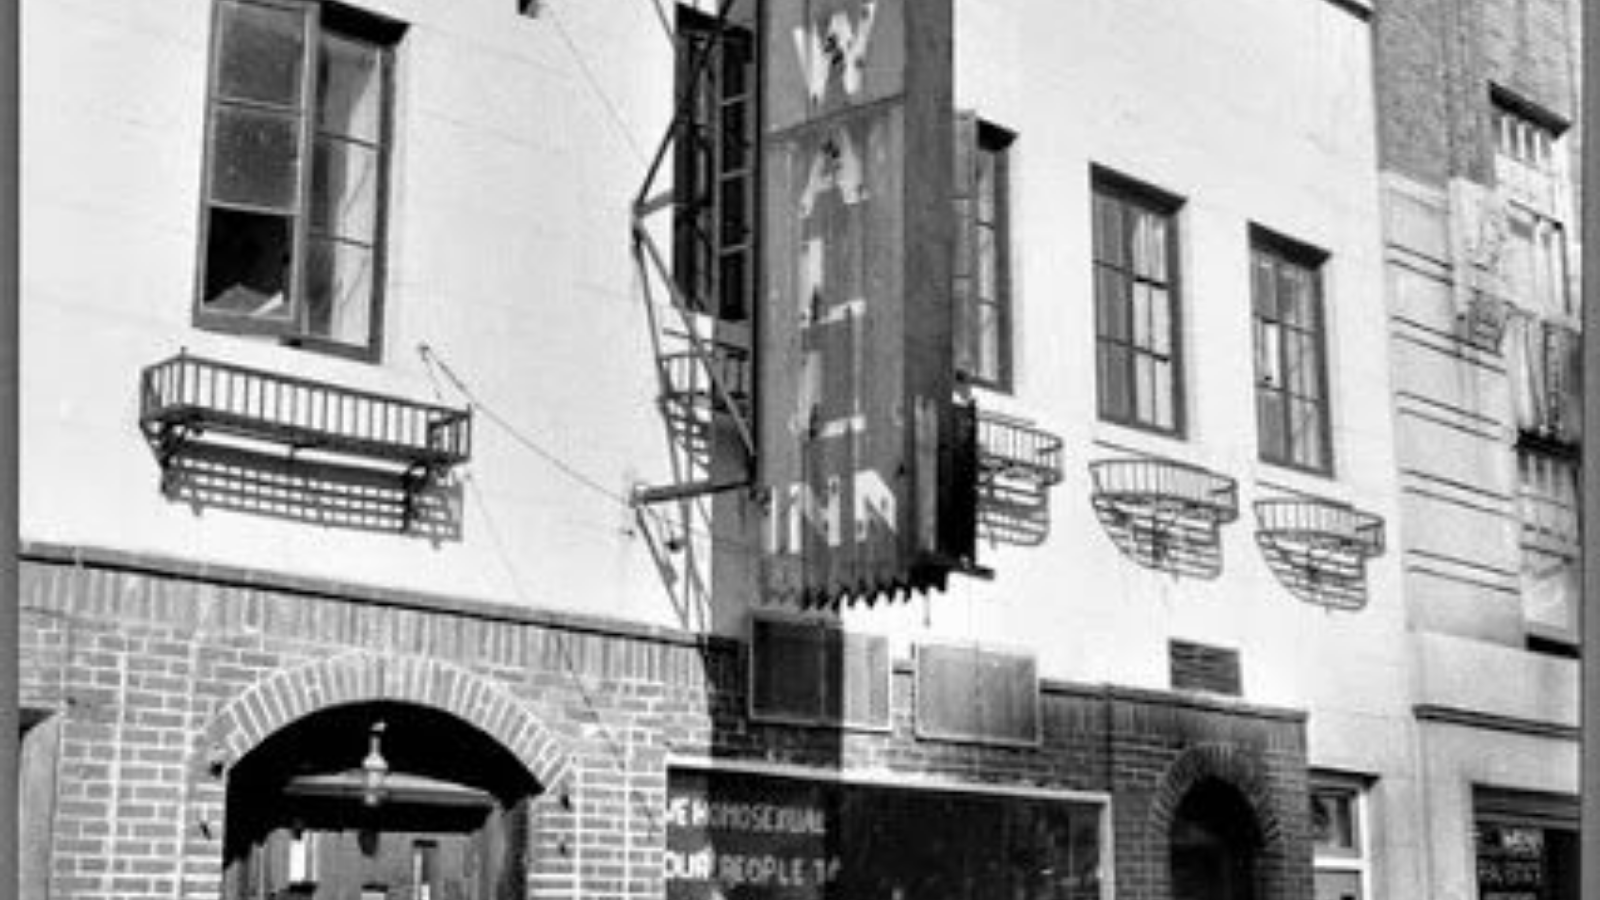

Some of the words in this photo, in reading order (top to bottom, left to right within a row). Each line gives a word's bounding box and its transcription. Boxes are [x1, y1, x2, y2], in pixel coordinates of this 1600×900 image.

[792, 2, 873, 436] WALL
[766, 469, 897, 554] INN
[717, 856, 806, 886] PEOPLE
